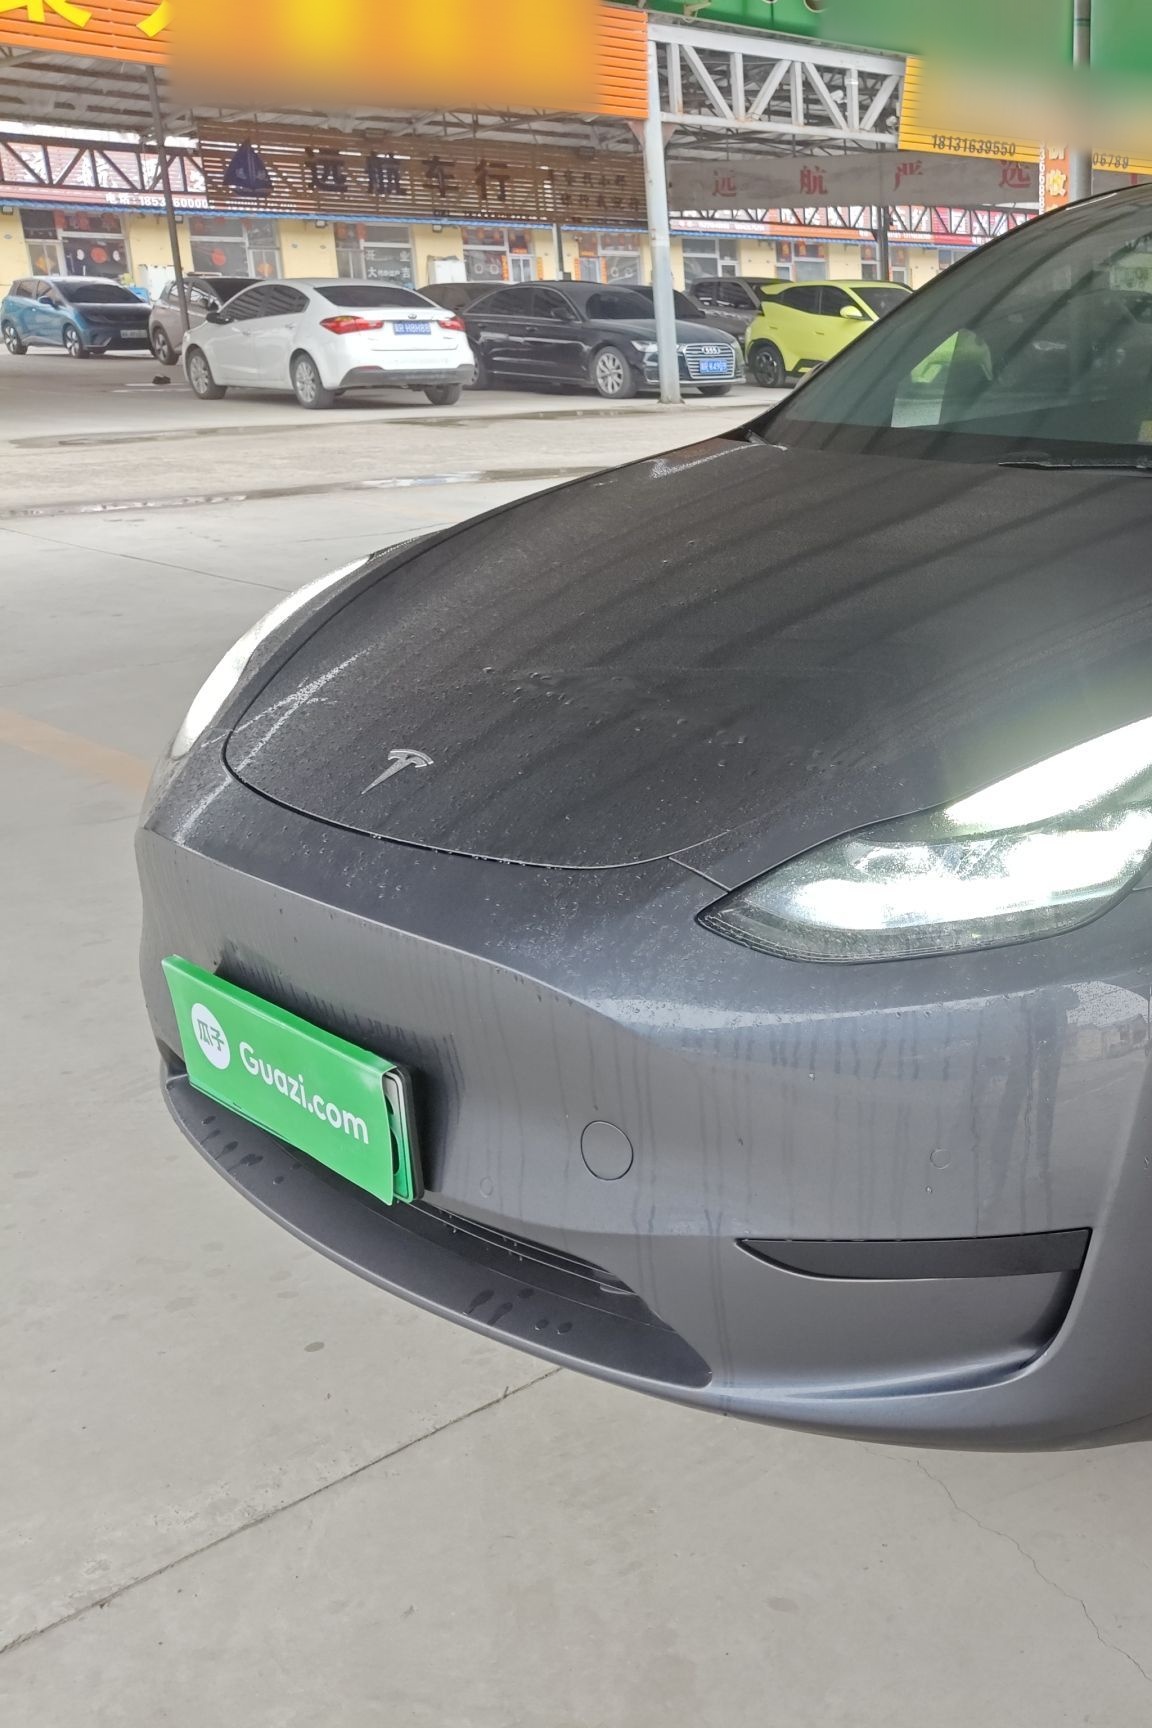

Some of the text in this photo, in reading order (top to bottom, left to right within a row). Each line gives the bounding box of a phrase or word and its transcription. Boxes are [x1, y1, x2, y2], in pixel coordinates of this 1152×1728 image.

[932, 134, 1016, 156] 18131639550
[197, 1019, 369, 1144] 瓜子 Guazi.com
